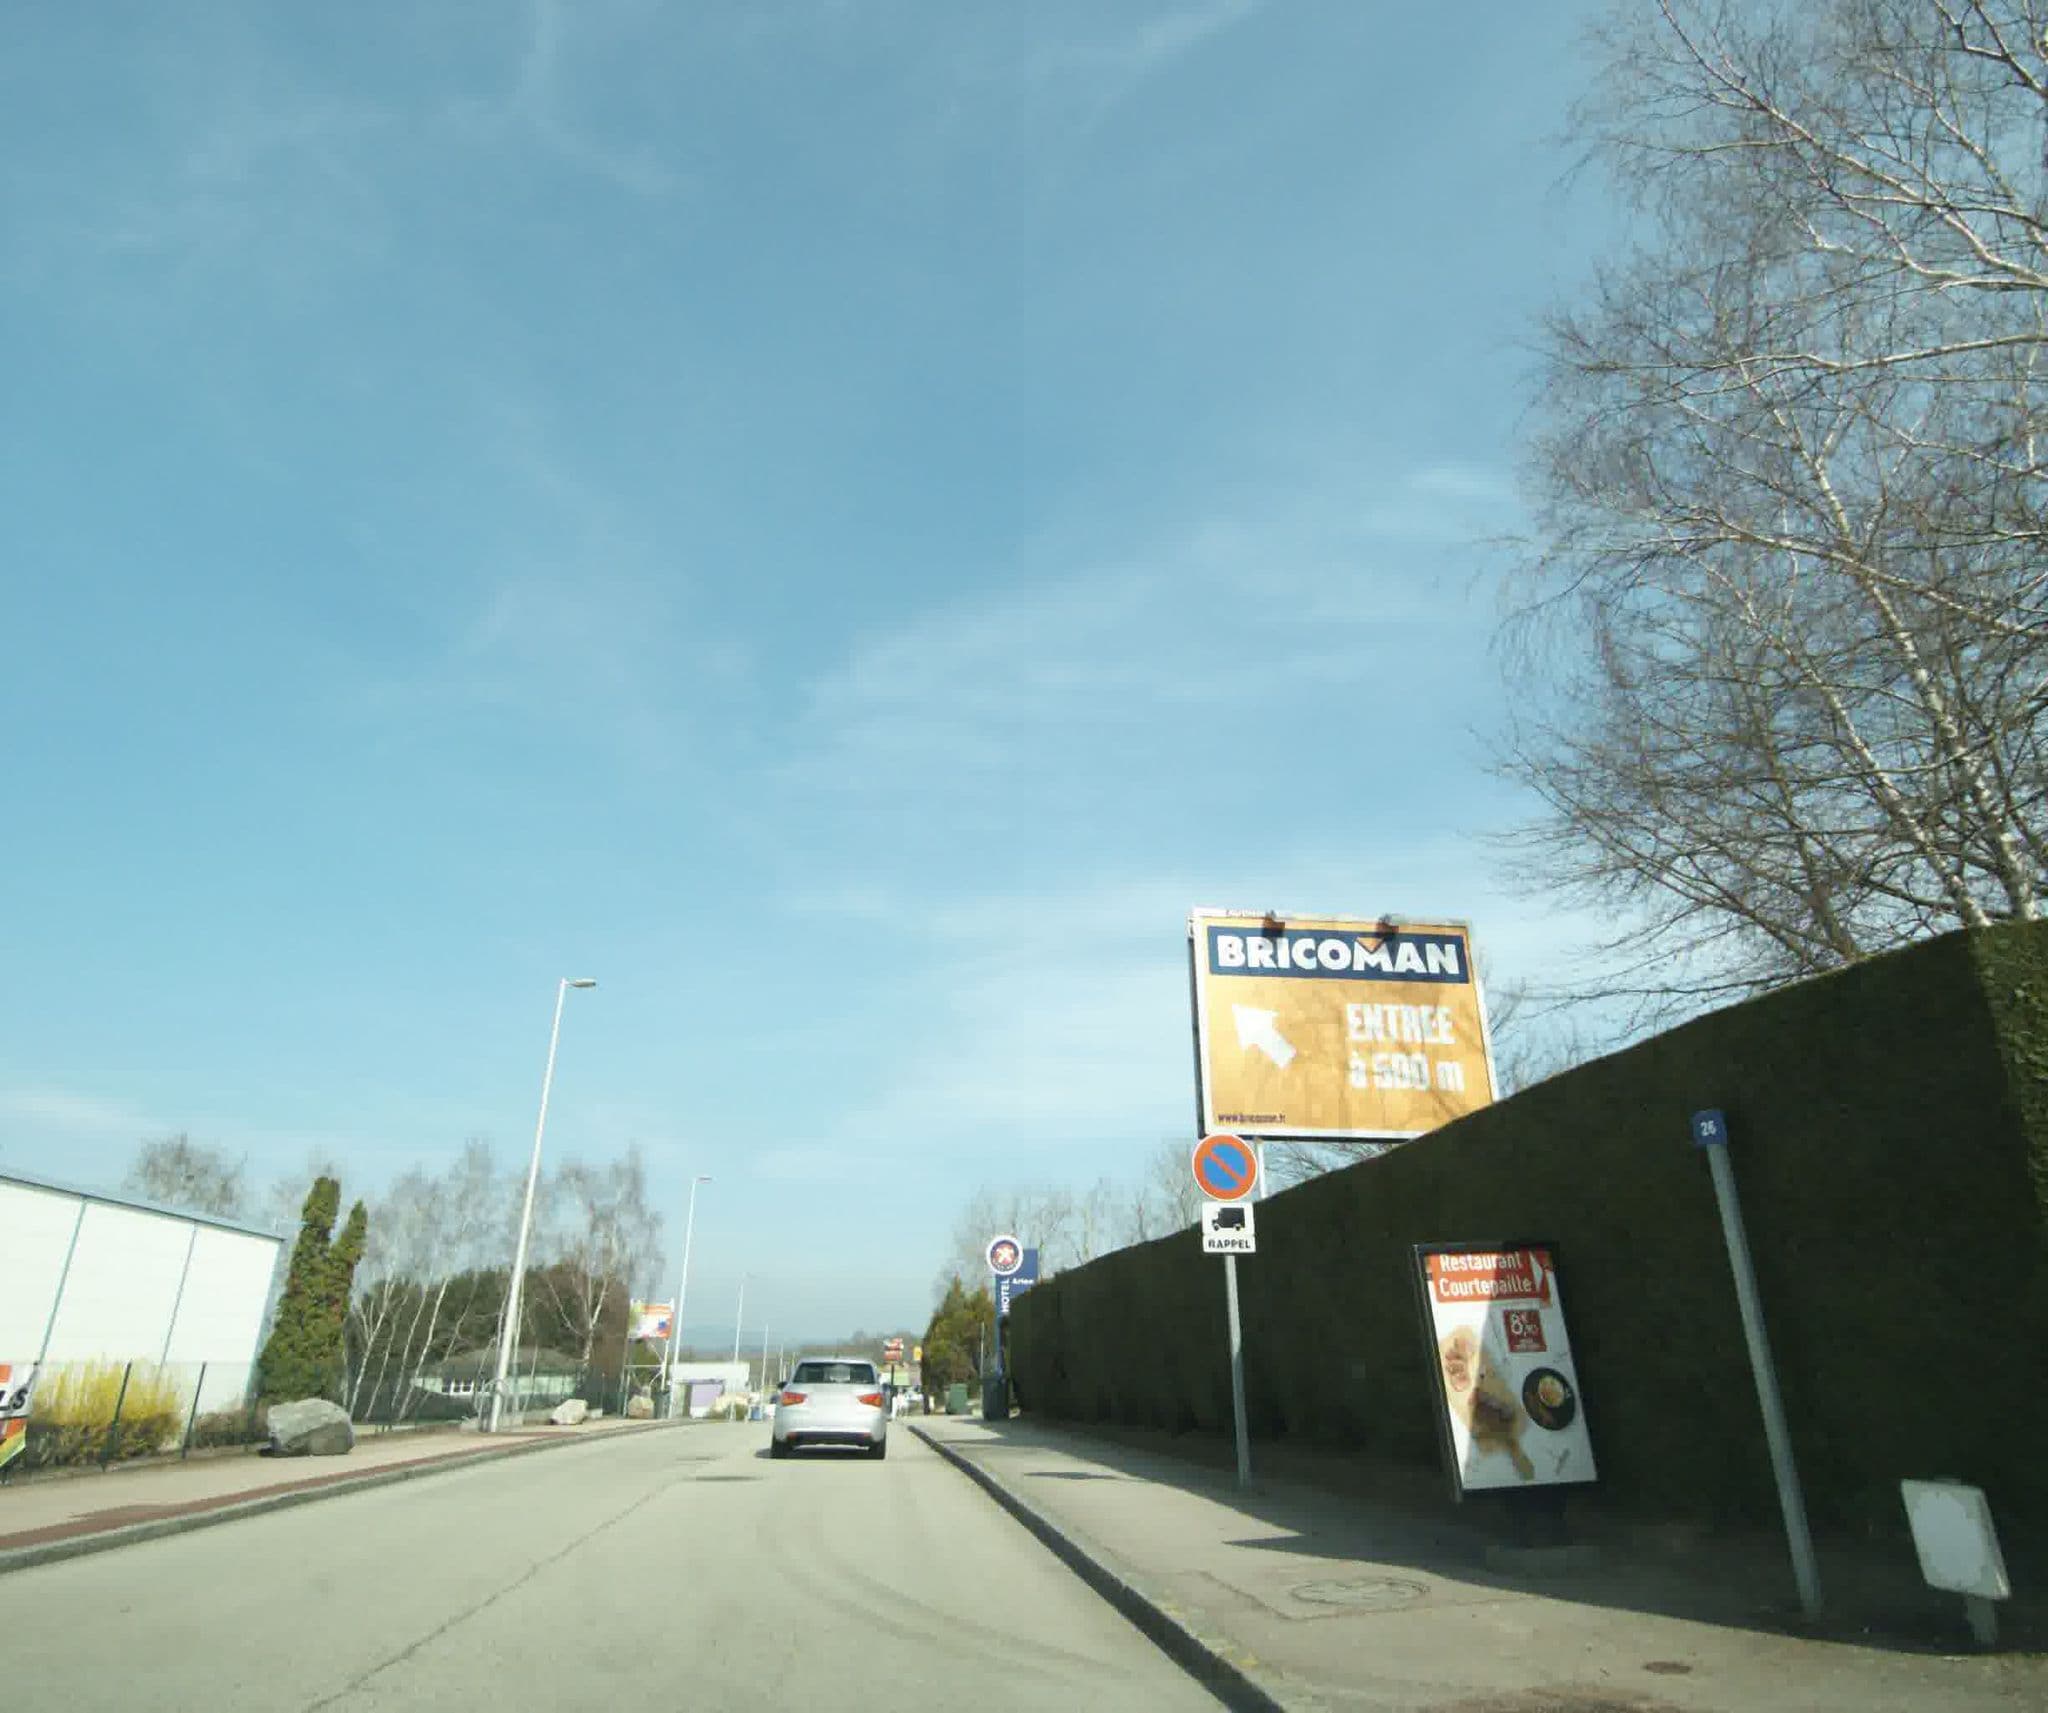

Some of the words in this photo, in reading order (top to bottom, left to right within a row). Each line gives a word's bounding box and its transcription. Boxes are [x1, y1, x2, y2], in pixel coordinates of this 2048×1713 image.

[1215, 934, 1461, 975] BRICOMAN
[1435, 1060, 1466, 1092] m
[1208, 1238, 1251, 1249] RAPPEL
[1440, 1251, 1523, 1272] Restaurant
[1440, 1275, 1533, 1297] Courtepaille
